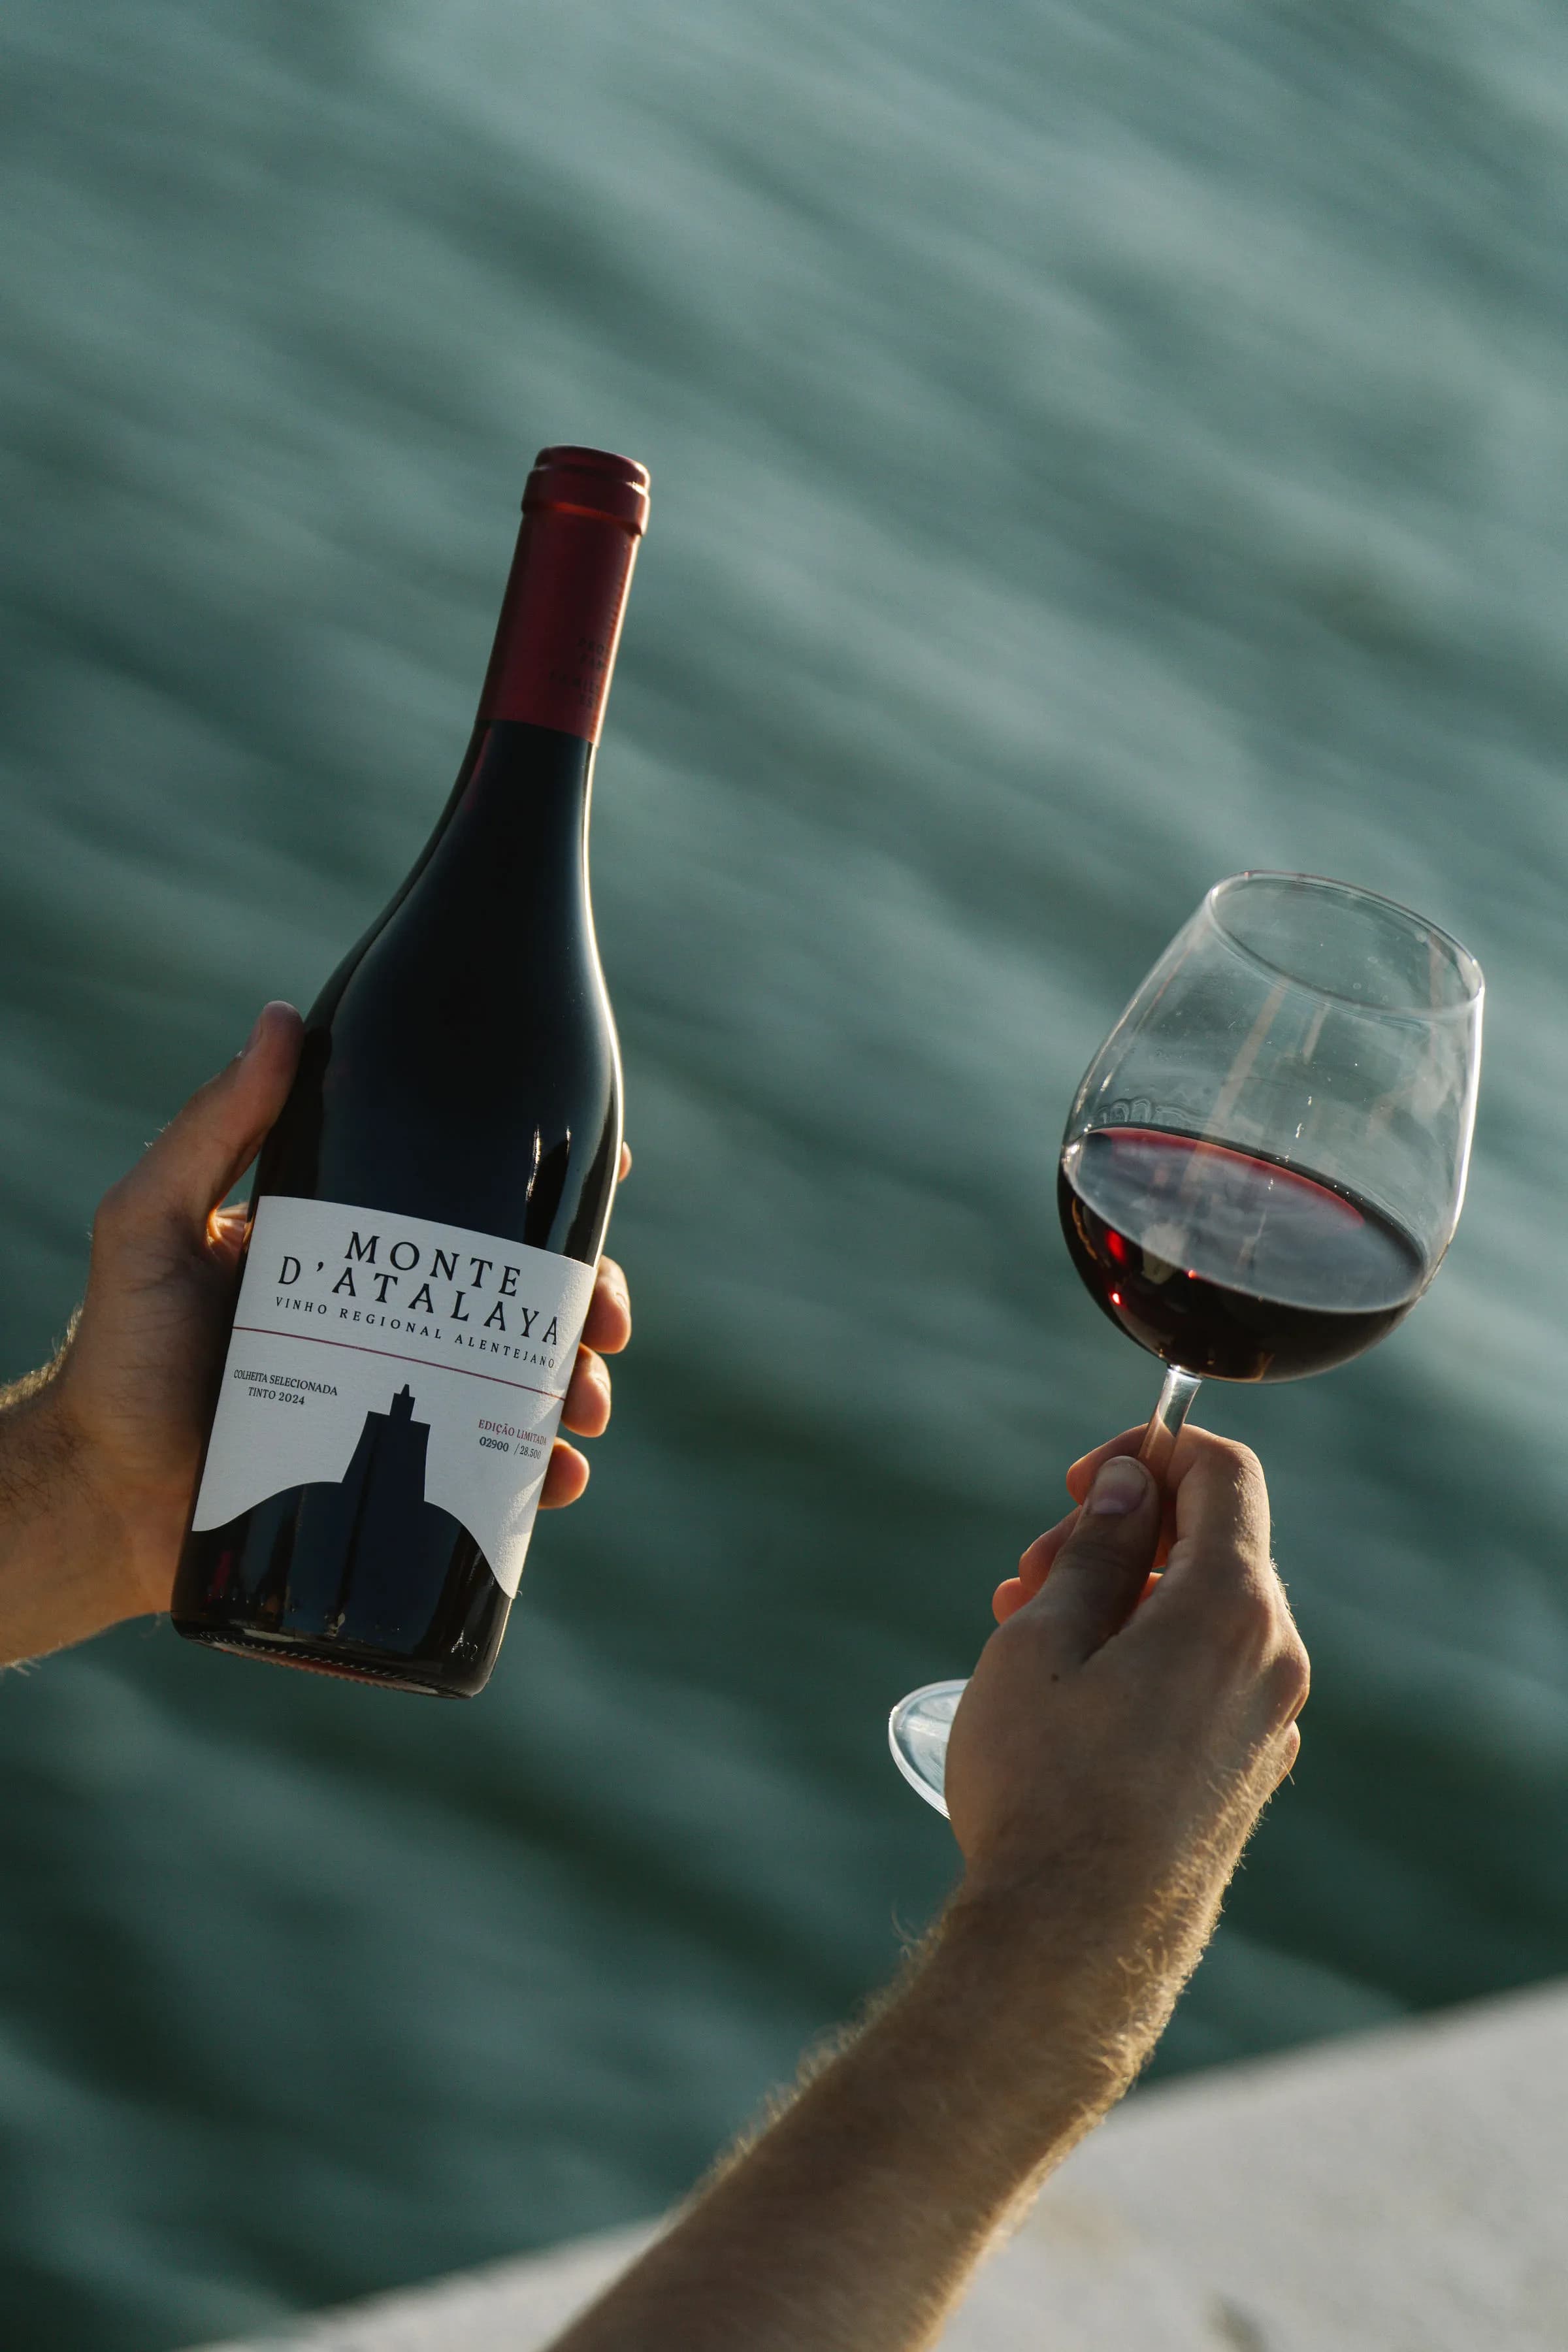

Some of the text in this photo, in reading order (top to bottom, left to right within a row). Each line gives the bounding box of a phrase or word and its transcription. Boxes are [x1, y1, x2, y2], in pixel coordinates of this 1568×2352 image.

[344, 1232, 521, 1297] MONTE
[278, 1256, 557, 1345] D'ATALAYA
[276, 1296, 555, 1369] VINHO REGIONAL ALENTEJANO
[234, 1369, 338, 1396] COLHEITA SELECIONADA
[248, 1386, 305, 1405] TINTO 2024
[478, 1419, 547, 1446] EDIÇÃO LIMITADA
[480, 1437, 509, 1452] 02900
